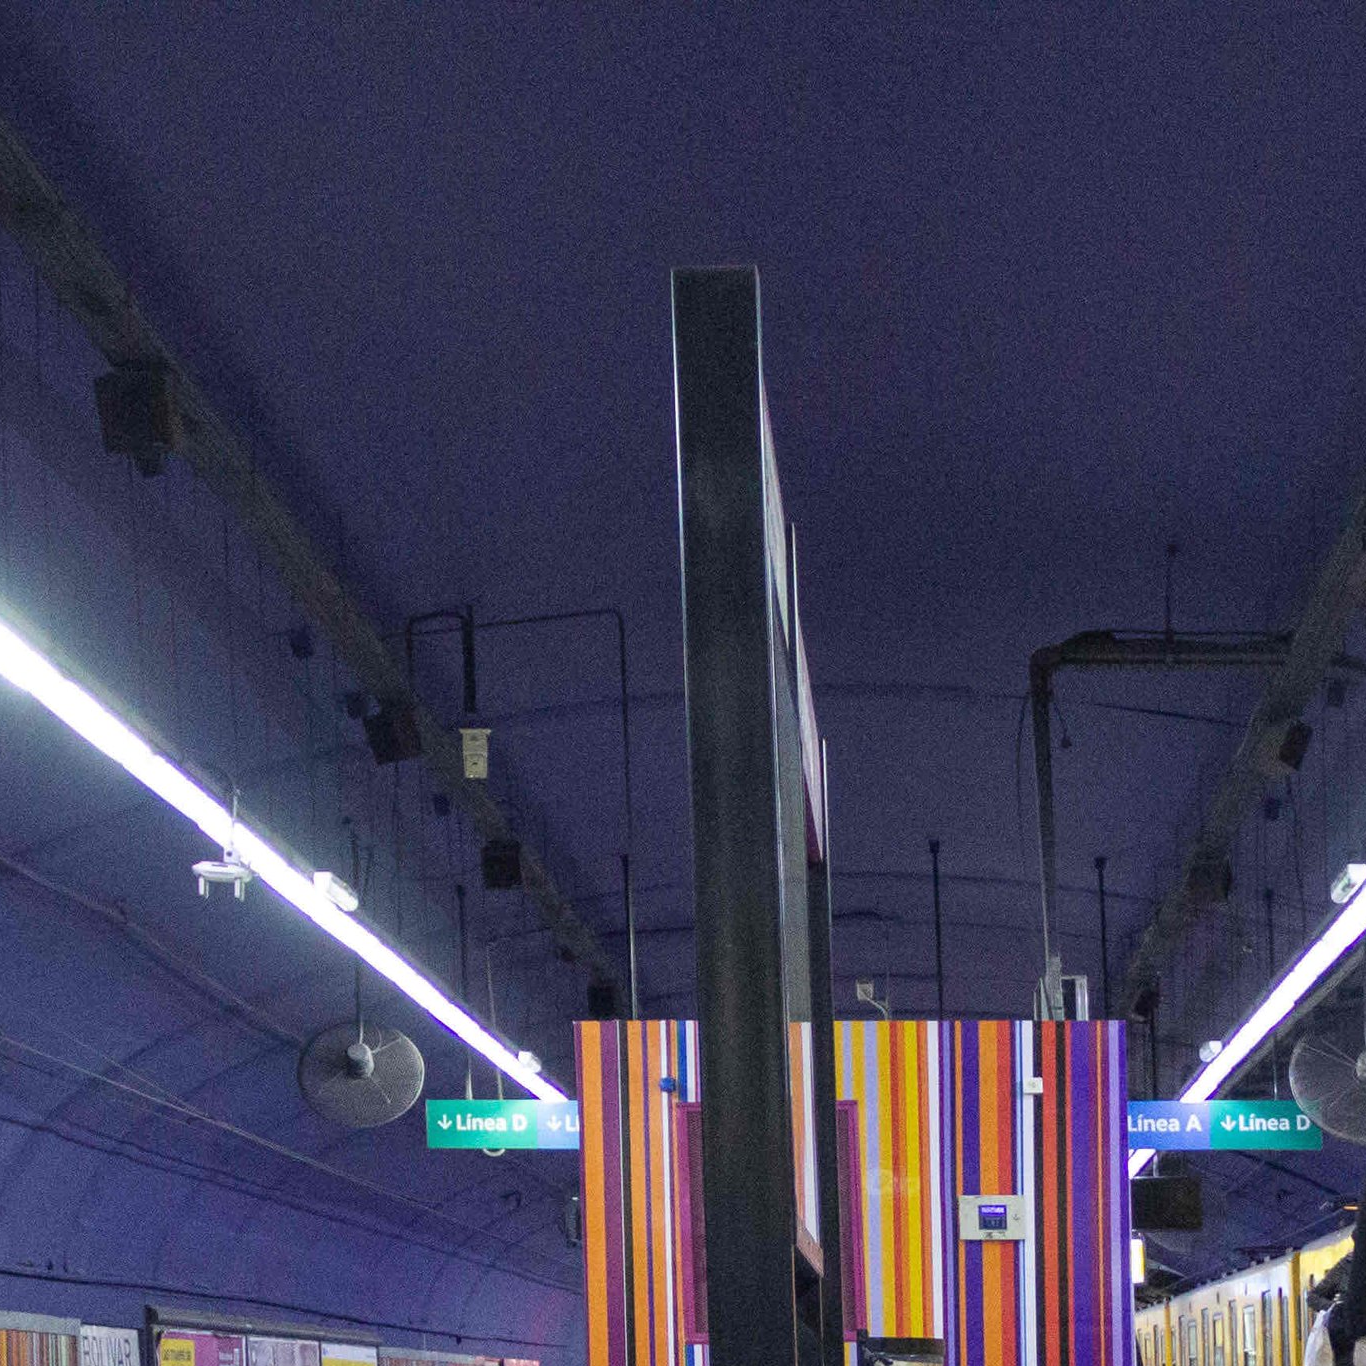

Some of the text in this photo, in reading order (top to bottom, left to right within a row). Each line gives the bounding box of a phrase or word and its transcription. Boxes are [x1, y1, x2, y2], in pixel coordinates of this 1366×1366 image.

[456, 1113, 528, 1132] Línea D
[1128, 1113, 1202, 1132] Línea A
[1239, 1113, 1311, 1132] Línea D
